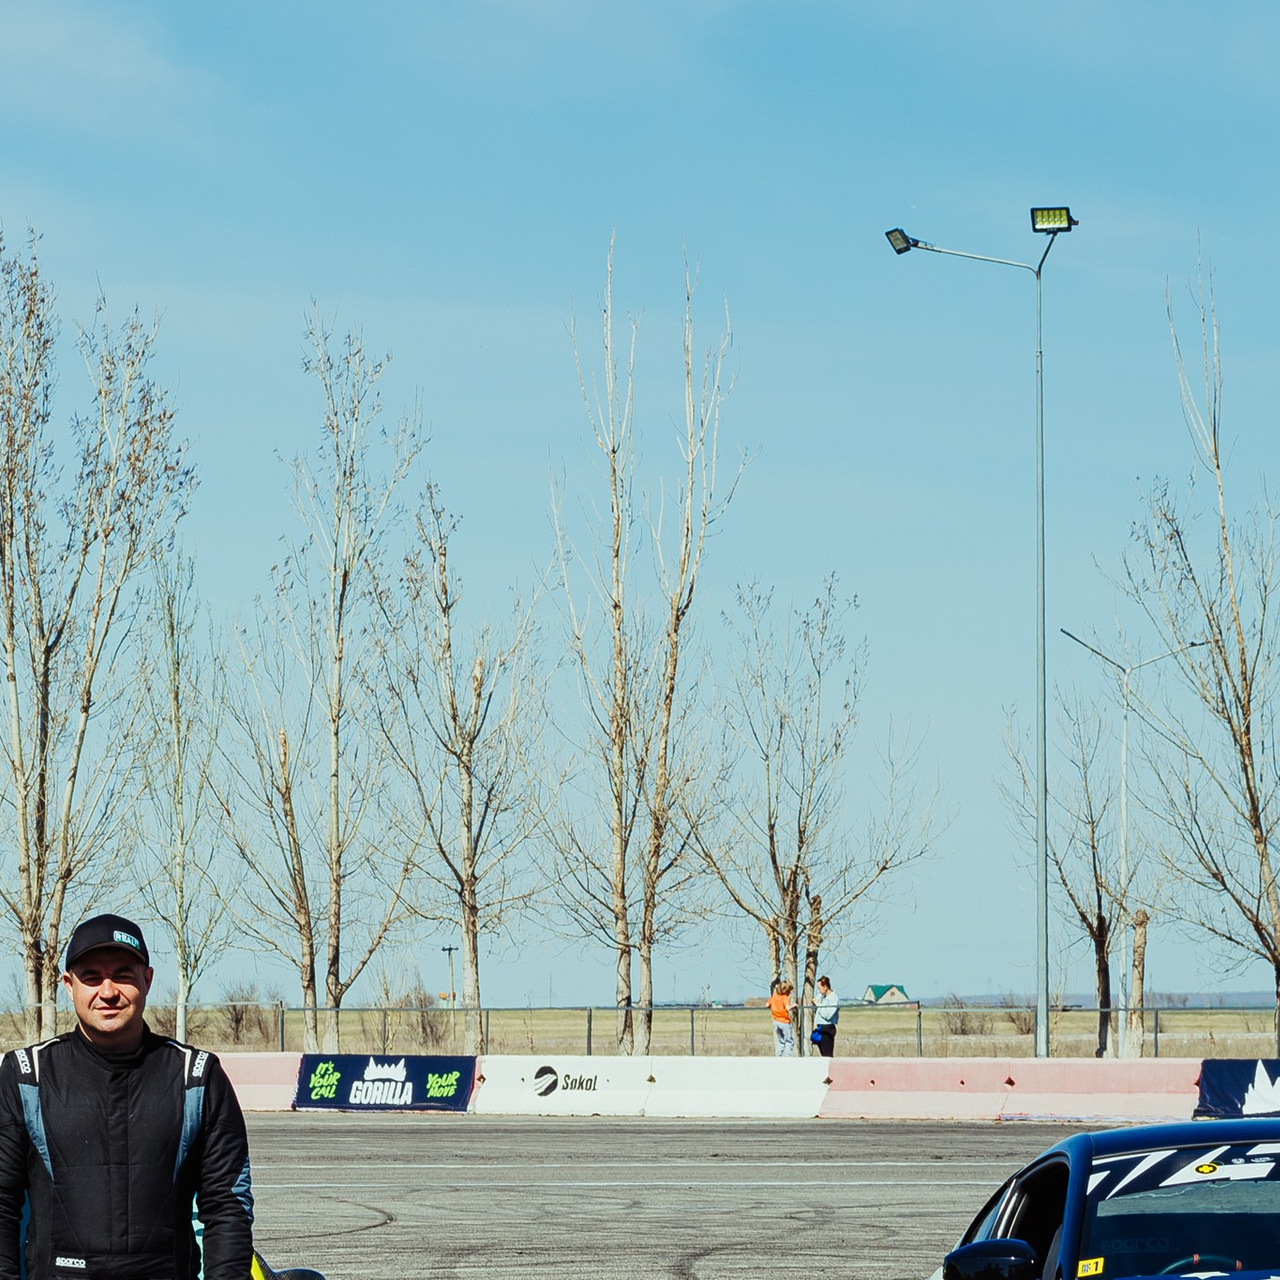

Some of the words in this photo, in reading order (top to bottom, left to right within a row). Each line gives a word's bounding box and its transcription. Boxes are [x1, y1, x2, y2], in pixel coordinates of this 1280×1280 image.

[316, 1061, 335, 1074] IT'S
[309, 1072, 341, 1088] YOUR
[426, 1071, 460, 1088] YOUR
[562, 1074, 598, 1091] Sokol
[311, 1085, 336, 1100] CALL
[349, 1081, 413, 1105] GORILLA
[427, 1085, 458, 1098] MOVE
[55, 1256, 86, 1268] sparco
